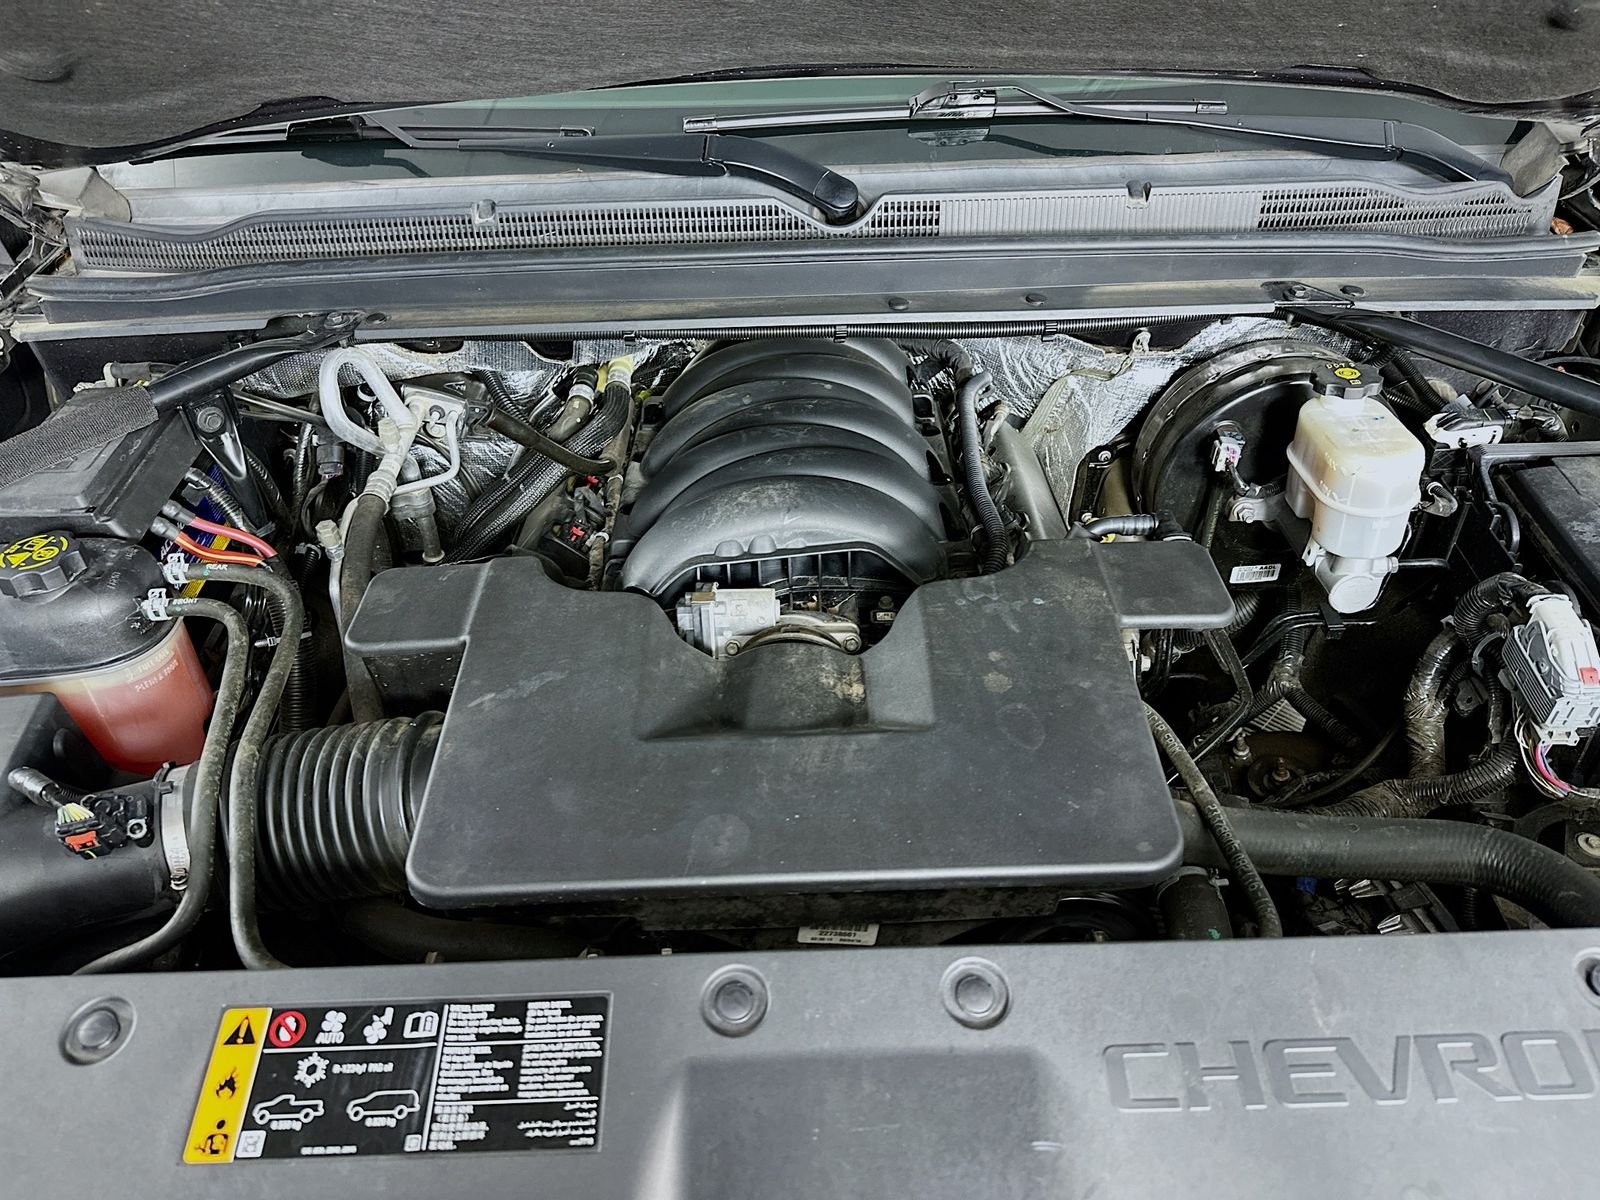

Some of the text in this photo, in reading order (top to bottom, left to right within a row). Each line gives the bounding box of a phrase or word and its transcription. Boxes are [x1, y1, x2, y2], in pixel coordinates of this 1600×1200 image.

[205, 563, 228, 571] REAR
[172, 598, 199, 606] FRONT
[315, 1031, 345, 1044] AUTO
[1102, 1029, 1600, 1113] CHEVRO
